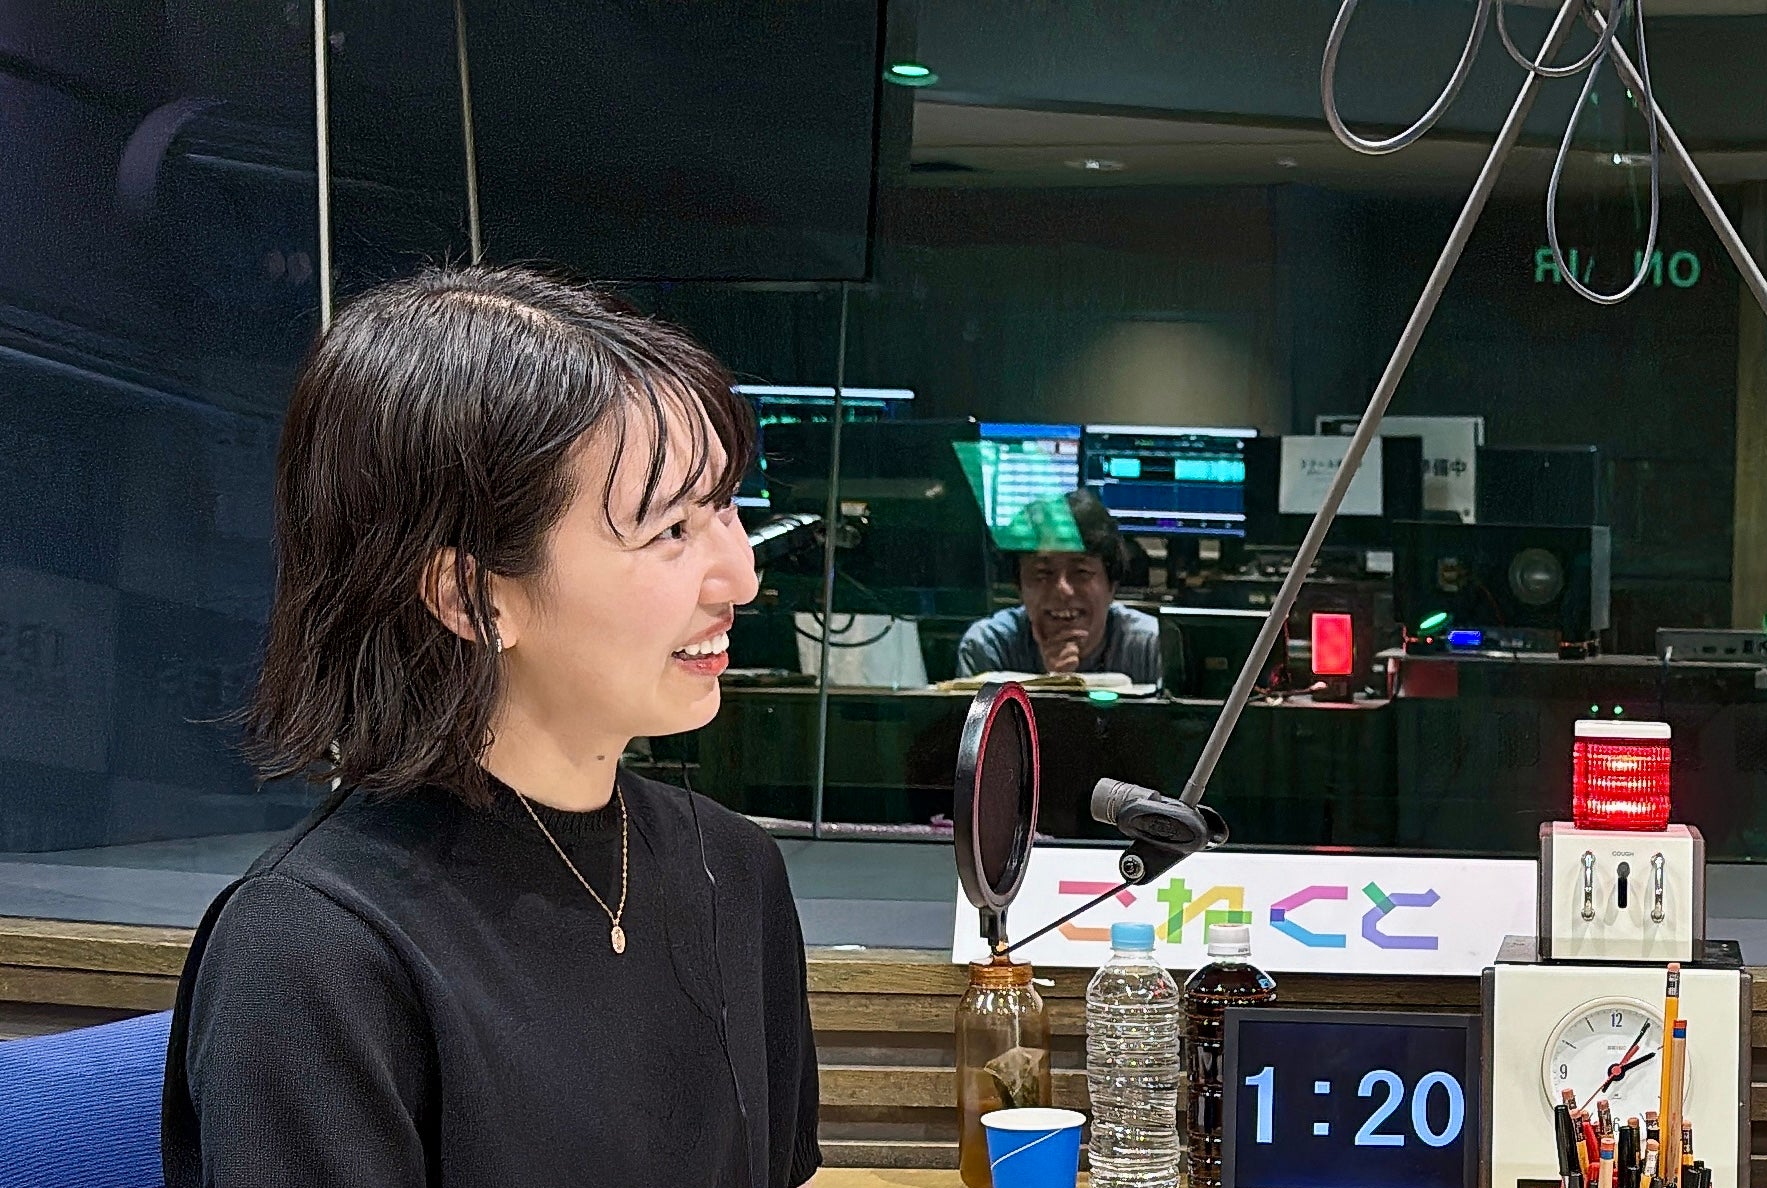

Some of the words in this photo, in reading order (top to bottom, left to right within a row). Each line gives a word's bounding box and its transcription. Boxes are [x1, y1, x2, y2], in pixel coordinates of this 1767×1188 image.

[1610, 1012, 1623, 1028] 12
[1559, 1063, 1568, 1080] 9
[1245, 1066, 1465, 1147] 1:20
